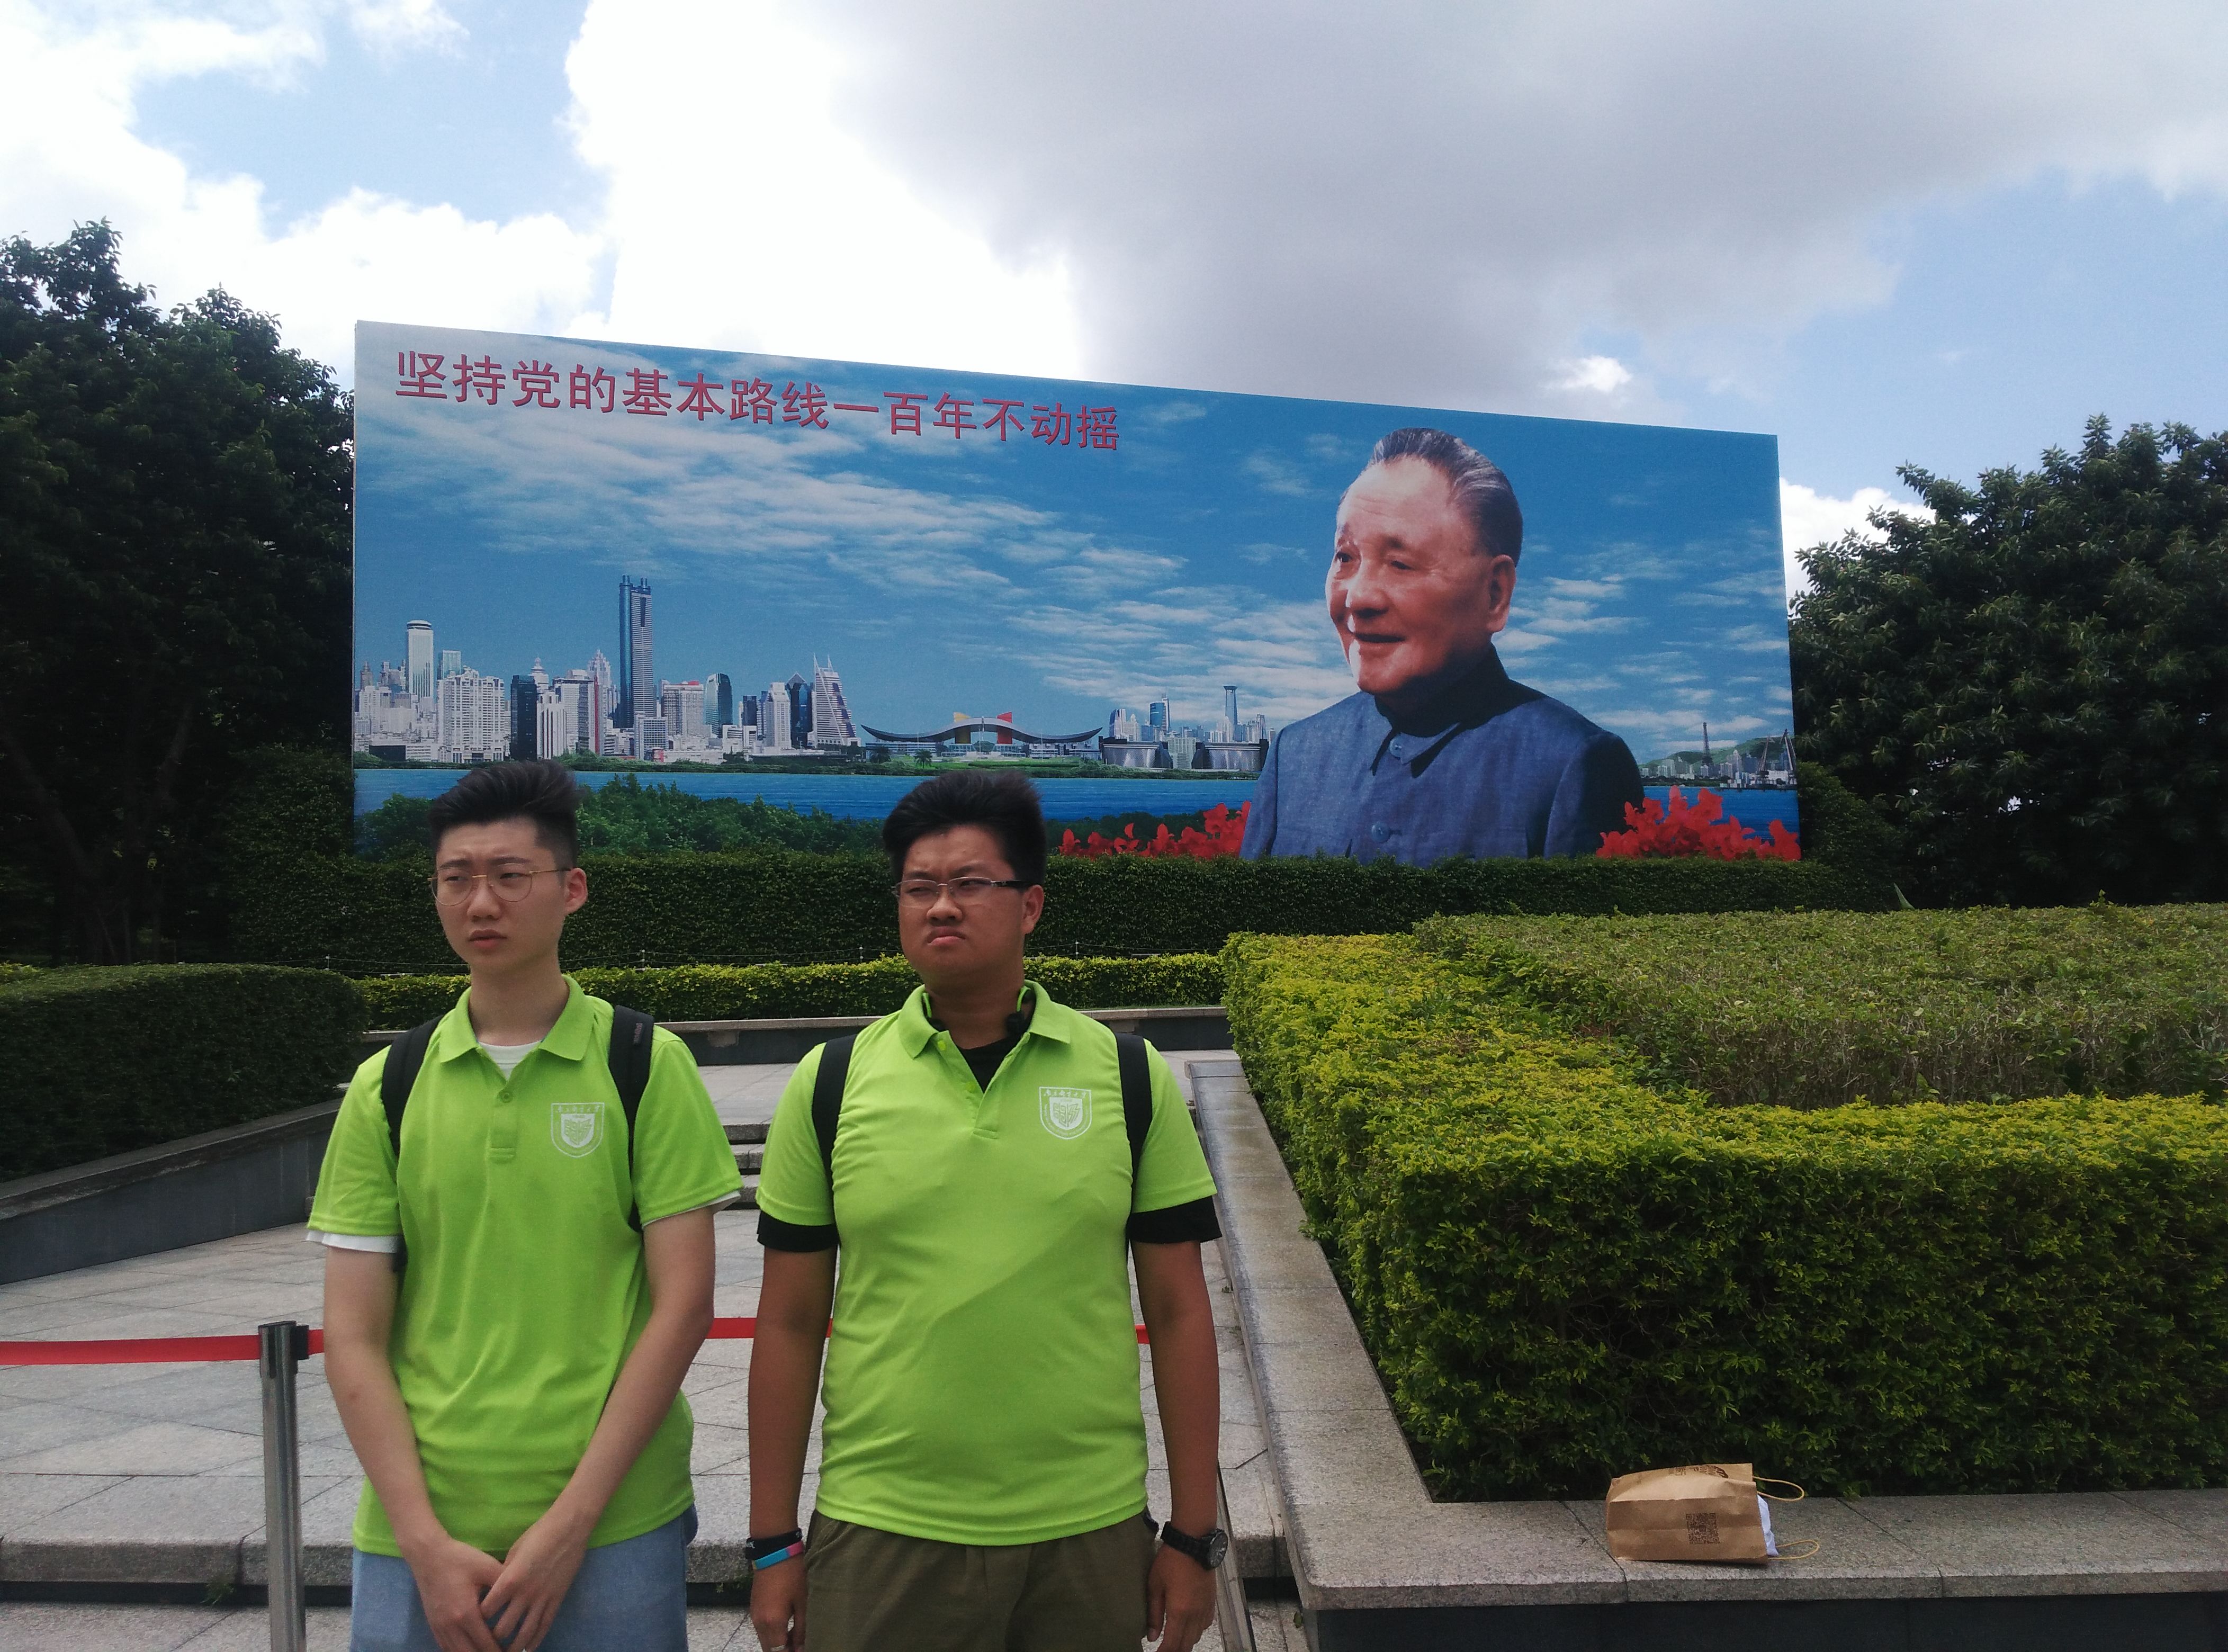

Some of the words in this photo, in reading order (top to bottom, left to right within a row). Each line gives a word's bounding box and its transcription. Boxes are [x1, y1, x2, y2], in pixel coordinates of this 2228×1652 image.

[396, 350, 1119, 451] 坚持党的基本路线一百年不动摇
